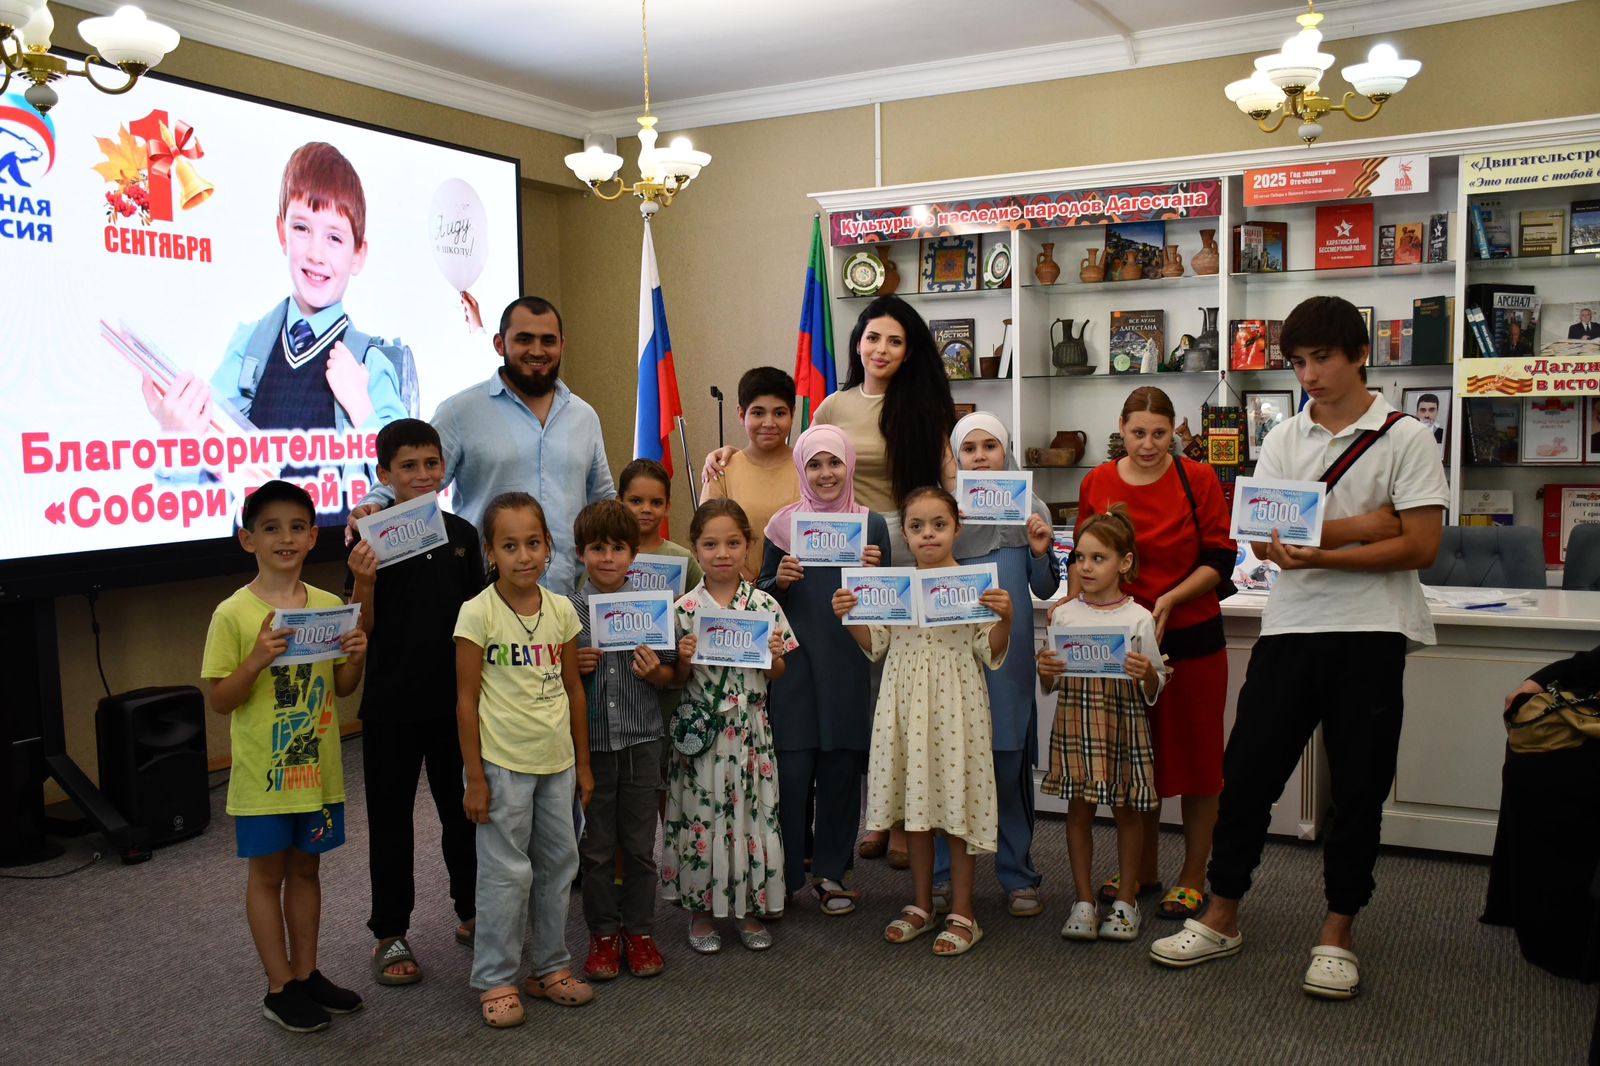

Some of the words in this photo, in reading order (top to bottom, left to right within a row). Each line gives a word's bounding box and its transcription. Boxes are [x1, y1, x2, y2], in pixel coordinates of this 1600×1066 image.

[1253, 172, 1287, 189] 2025
[1468, 177, 1502, 188] «Это
[1505, 175, 1539, 185] наша
[1542, 174, 1549, 182] с
[1552, 167, 1593, 180] тобой
[938, 205, 1021, 227] наследие
[1025, 200, 1102, 220] народов
[1105, 192, 1208, 214] Дагестана
[103, 225, 213, 264] СЕНТЯБРЯ
[1497, 296, 1531, 308] АРСЕНАЛ
[1119, 324, 1157, 332] ДАГЕСТАНА
[1536, 380, 1548, 392] в
[1553, 378, 1600, 392] исто
[44, 483, 227, 529] «Собери
[976, 489, 1012, 508] 5000
[1257, 499, 1300, 524] 5000
[388, 518, 426, 546] 5000
[811, 532, 847, 550] 5000
[632, 572, 667, 590] 5000
[861, 587, 898, 606] 5000
[938, 586, 979, 607] 5000
[613, 612, 653, 632] 5000
[294, 624, 337, 646] 5000
[714, 628, 753, 649] 5000
[1072, 644, 1111, 661] 5000
